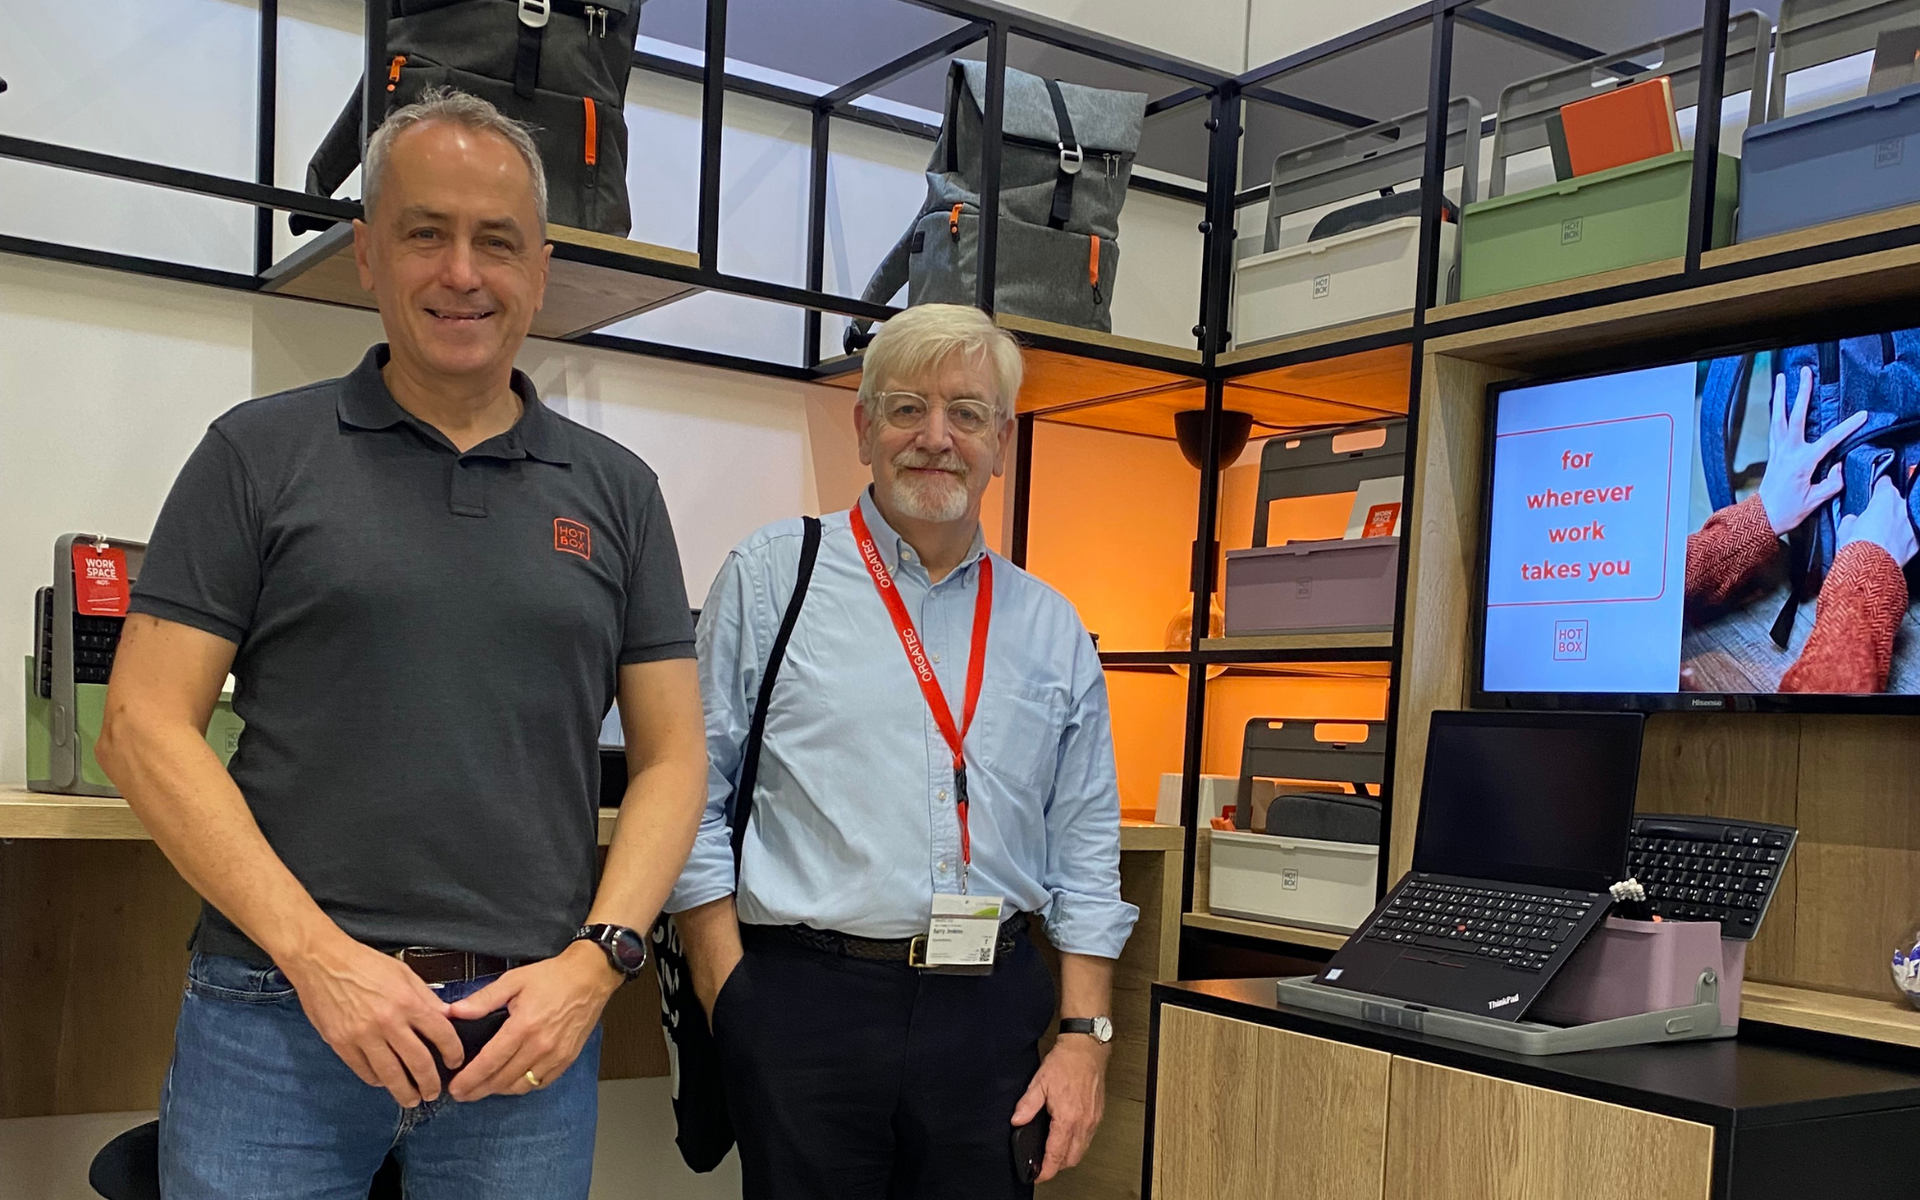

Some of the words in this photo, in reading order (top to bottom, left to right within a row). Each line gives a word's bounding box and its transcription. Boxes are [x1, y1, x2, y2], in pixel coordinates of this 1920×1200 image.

[1564, 221, 1579, 231] HOT
[1564, 229, 1579, 240] BOX
[1315, 278, 1328, 287] HOT
[1315, 286, 1327, 295] BOX
[1561, 450, 1594, 470] for
[1526, 483, 1634, 509] wherever
[560, 526, 585, 540] HOT
[1548, 520, 1606, 543] work
[561, 535, 585, 553] BOX
[85, 557, 115, 569] WORK
[861, 538, 891, 589] ORGATEC
[86, 567, 117, 578] SPACE
[1521, 560, 1581, 581] takes
[1587, 559, 1631, 582] you
[1559, 628, 1583, 640] HOT
[1558, 641, 1582, 653] BOX
[902, 628, 933, 682] ORGATEC
[1488, 993, 1520, 1010] ThinkPad
